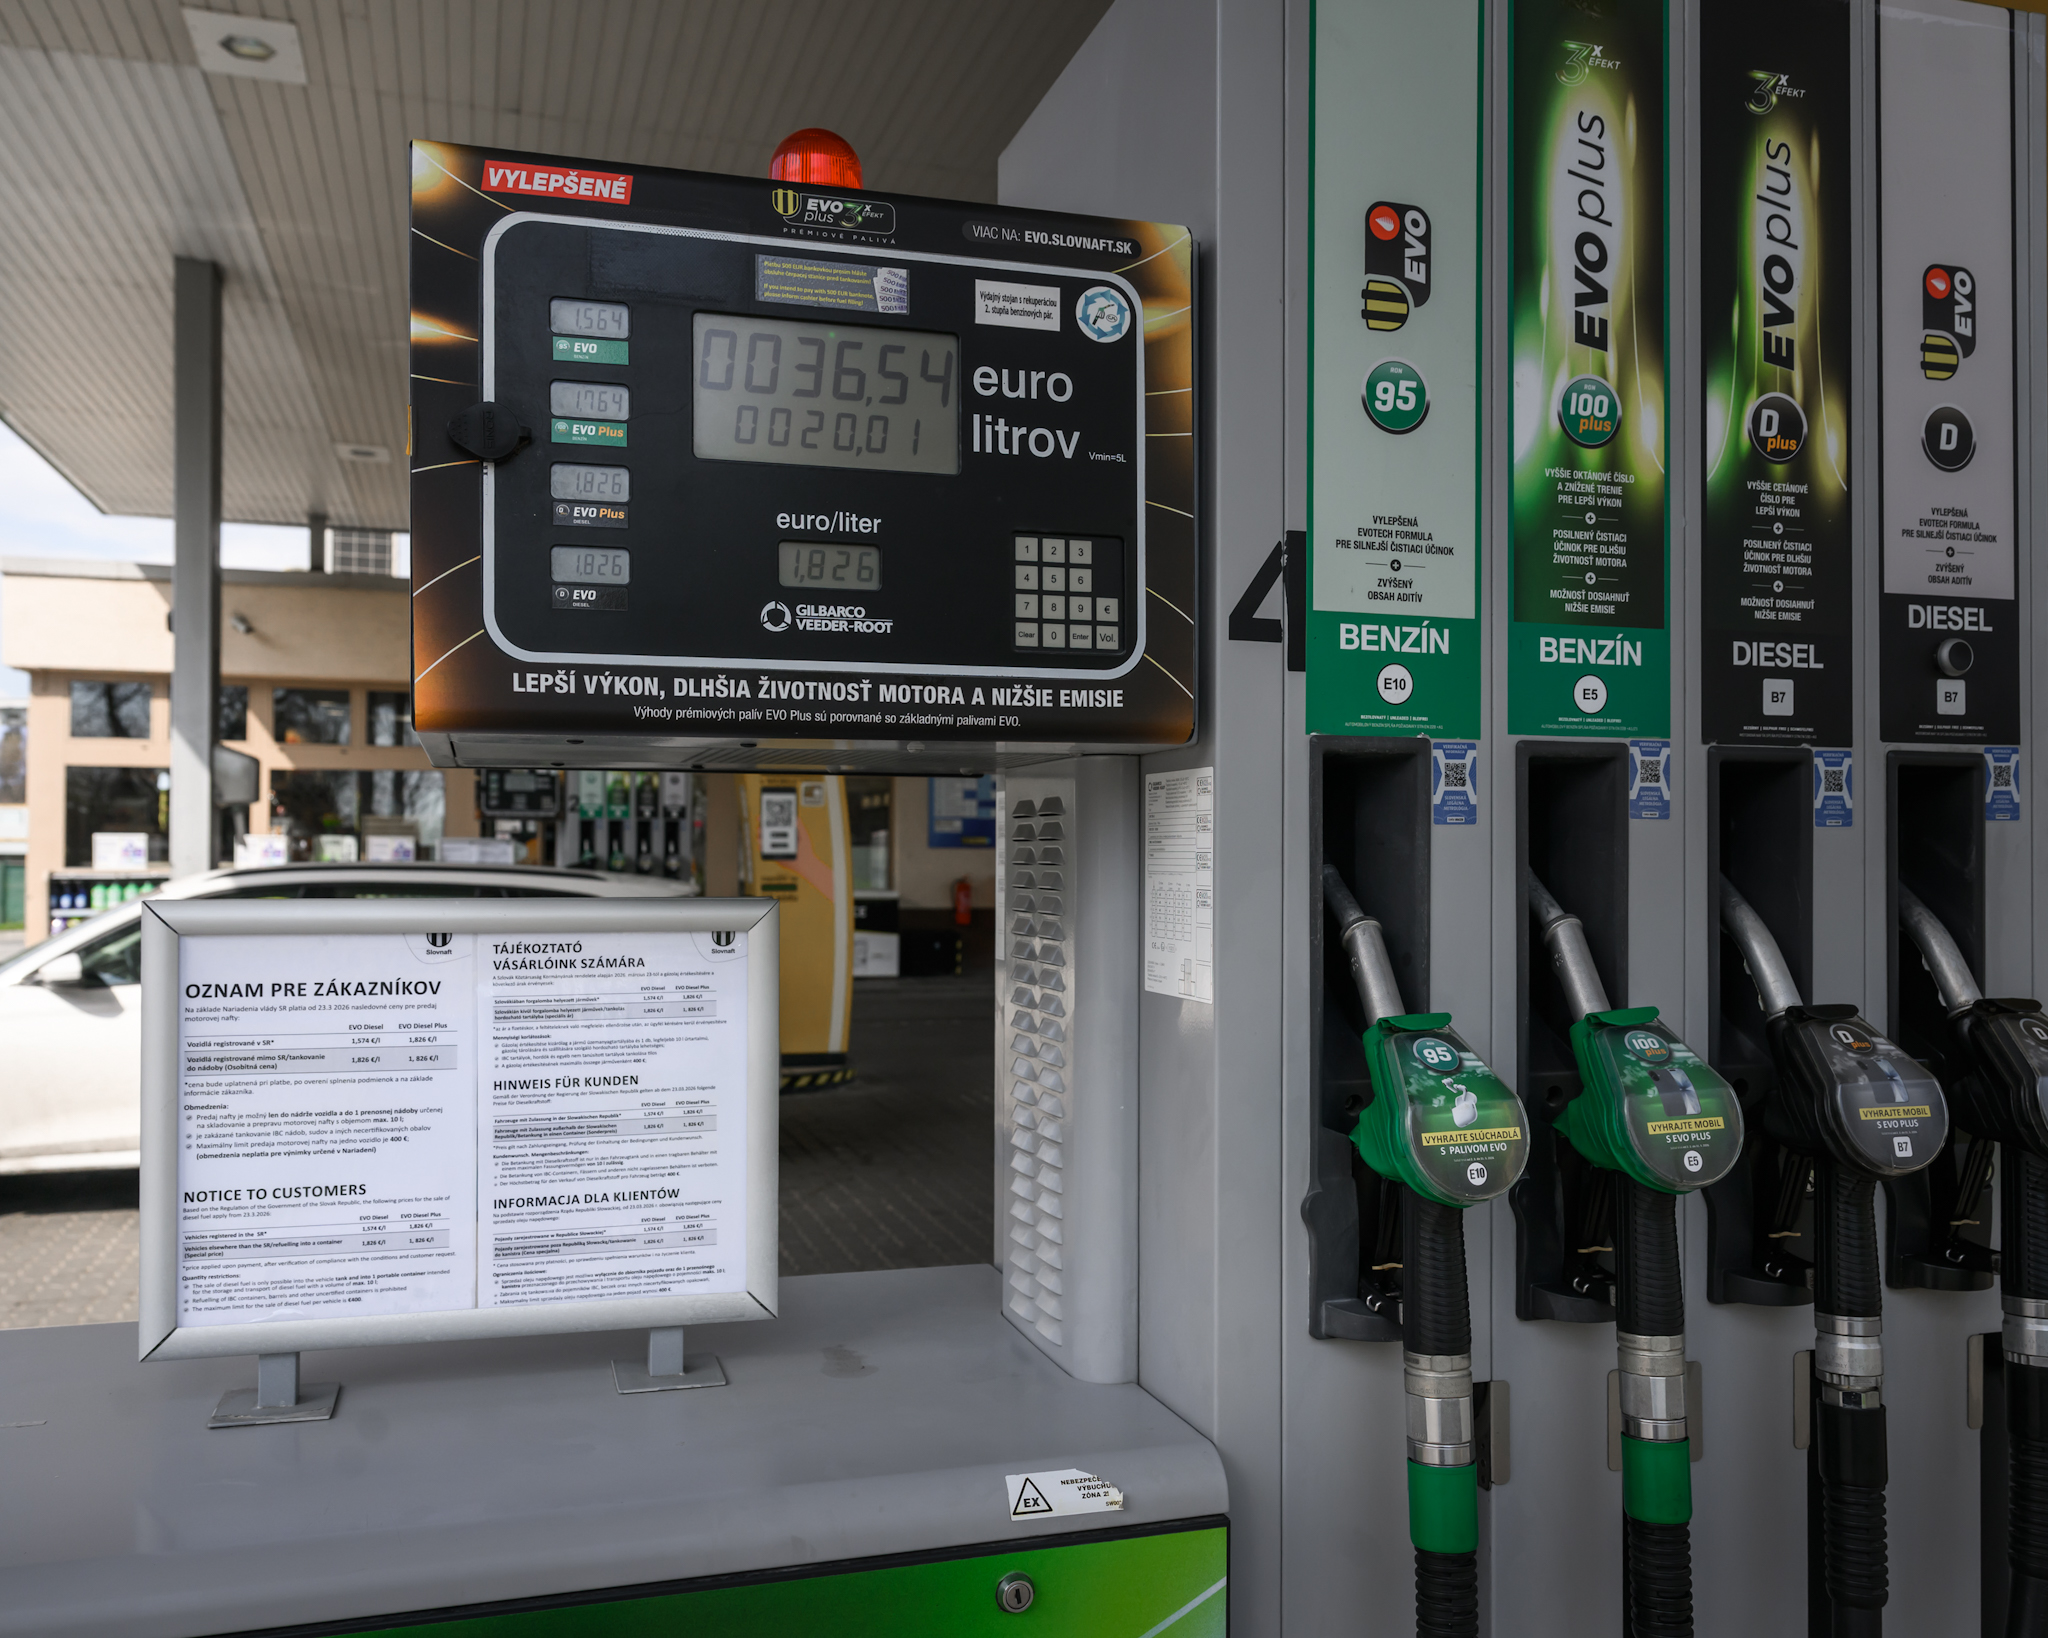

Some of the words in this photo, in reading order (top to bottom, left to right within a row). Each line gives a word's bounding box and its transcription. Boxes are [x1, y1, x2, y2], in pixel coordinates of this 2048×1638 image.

[1567, 110, 1613, 227] plus
[488, 167, 627, 200] VYLEPŠENÉ
[1756, 137, 1798, 251] plus
[806, 198, 844, 213] EVO
[804, 210, 834, 223] plus
[783, 227, 844, 239] PRÉMIOVÉ
[853, 235, 896, 244] PALIVÁ
[973, 225, 998, 240] VIAC
[1001, 228, 1021, 242] NA:
[1024, 231, 1132, 255] EVO.SLOVNAFT.SK
[1404, 209, 1427, 285] EVO
[1002, 294, 1018, 305] stojan
[1023, 296, 1057, 307] rekuperáciou
[1574, 231, 1608, 353] EVO
[985, 304, 990, 313] 2.
[1954, 270, 1973, 337] EVO
[576, 307, 622, 331] 1,564
[1763, 254, 1795, 372] EVO
[574, 342, 597, 354] EVO
[700, 328, 954, 408] 0036,54
[973, 365, 1074, 402] euro
[1374, 380, 1417, 412] 95
[1569, 392, 1609, 418] 100
[572, 424, 595, 436] EVO
[598, 426, 624, 437] Plus
[734, 405, 920, 457] 0020,01
[1579, 415, 1612, 434] plus
[1759, 408, 1780, 438] D
[973, 413, 1080, 459] litrov
[1766, 435, 1797, 453] plus
[1939, 423, 1959, 451] D
[1088, 451, 1127, 463] Vmin=5L
[576, 472, 622, 495] 1,826
[1545, 467, 1572, 479] VYŠŠIE
[1573, 469, 1612, 482] OKTÁNOVÉ
[1613, 471, 1635, 484] ČÍSLO
[1557, 482, 1563, 491] A
[1564, 482, 1595, 493] ZNÍŽENÉ
[1597, 484, 1623, 496] TRENIE
[1558, 495, 1573, 504] PRE
[1574, 495, 1595, 506] LEPŠÍ
[1596, 497, 1622, 508] VÝKON
[573, 506, 597, 518] EVO
[599, 508, 625, 519] Plus
[776, 510, 882, 534] euro/liter
[1372, 515, 1419, 528] VYLEPŠENÁ
[1357, 528, 1393, 539] EVOTECH
[1395, 530, 1433, 542] FORMULA
[1335, 539, 1351, 549] PRE
[1353, 539, 1389, 552] SILNEJŠÍ
[1390, 541, 1423, 554] ČISTIACI
[1425, 543, 1454, 556] ÚČINOK
[576, 553, 622, 577] 1,826
[794, 549, 874, 584] 1,826
[1377, 578, 1413, 590] ZVÝŠENÝ
[573, 589, 596, 600] EVO
[1229, 530, 1306, 672] 4
[1367, 591, 1395, 601] OBSAH
[1397, 591, 1423, 603] ADITÍV
[796, 604, 866, 618] GILBARCO
[1908, 604, 1993, 632] DIESEL
[796, 619, 893, 634] VEEDER-ROOT
[1339, 620, 1449, 655] BENZÍN
[1539, 633, 1642, 667] BENZÍN
[1732, 640, 1824, 669] DIESEL
[512, 669, 576, 694] LEPŠÍ
[583, 671, 665, 700] VÝKON,
[674, 675, 751, 699] DLHŠIA
[757, 676, 873, 702] ŽIVOTNOSŤ
[879, 684, 965, 705] MOTORA
[971, 687, 986, 706] A
[991, 684, 1053, 707] NIŽŠIE
[1060, 689, 1124, 708] EMISIE
[1383, 678, 1406, 690] E10
[1583, 688, 1598, 700] E5
[1771, 691, 1786, 703] B7
[1944, 691, 1958, 703] B7
[633, 705, 672, 720] Výhody
[675, 707, 735, 721] prémiových
[738, 708, 763, 721] palív
[765, 710, 787, 720] EVO
[790, 710, 811, 721] Plus
[814, 709, 827, 722] sú
[830, 711, 882, 725] porovnané
[885, 715, 896, 724] so
[899, 712, 954, 726] základnými
[957, 714, 996, 727] palivami
[999, 716, 1021, 727] EVO.
[493, 940, 583, 955] TÁJÉKOZTATÓ
[493, 956, 577, 971] VÁSÁRLÓINK
[580, 955, 645, 969] SZÁMÁRA
[185, 981, 264, 999] OZNAM
[271, 982, 307, 997] PRE
[313, 977, 442, 997] ZÁKAZNÍKOV
[260, 1005, 277, 1013] vlády
[288, 1005, 307, 1013] platia
[1423, 1046, 1452, 1064] 95
[493, 1078, 551, 1091] HINWEIS
[555, 1075, 581, 1089] FÜR
[584, 1075, 639, 1088] KUNDEN
[1862, 1109, 1901, 1119] VYHRAJTE
[1902, 1107, 1928, 1117] MOBIL
[1651, 1120, 1693, 1133] VYHRAJTE
[1694, 1119, 1722, 1129] MOBIL
[1876, 1121, 1882, 1129] S
[1882, 1120, 1899, 1129] EVO
[1900, 1119, 1919, 1128] PLUS
[1424, 1132, 1469, 1144] VYHRAJTE
[1470, 1129, 1519, 1142] SLÚCHADLÁ
[1665, 1135, 1671, 1143] S
[1672, 1133, 1690, 1143] EVO
[1691, 1131, 1711, 1142] PLUS
[1440, 1146, 1446, 1156] S
[1449, 1143, 1489, 1155] PALIVOM
[1490, 1142, 1508, 1152] EVO
[1897, 1142, 1908, 1152] B7
[1687, 1156, 1699, 1167] E5
[1469, 1167, 1486, 1180] E10
[184, 1189, 242, 1203] NOTICE
[246, 1188, 267, 1200] TO
[272, 1184, 366, 1199] CUSTOMERS
[493, 1195, 580, 1210] INFORMACJA
[584, 1192, 610, 1204] DLA
[613, 1187, 680, 1203] KLIENTÓW
[1023, 1497, 1040, 1508] EX
